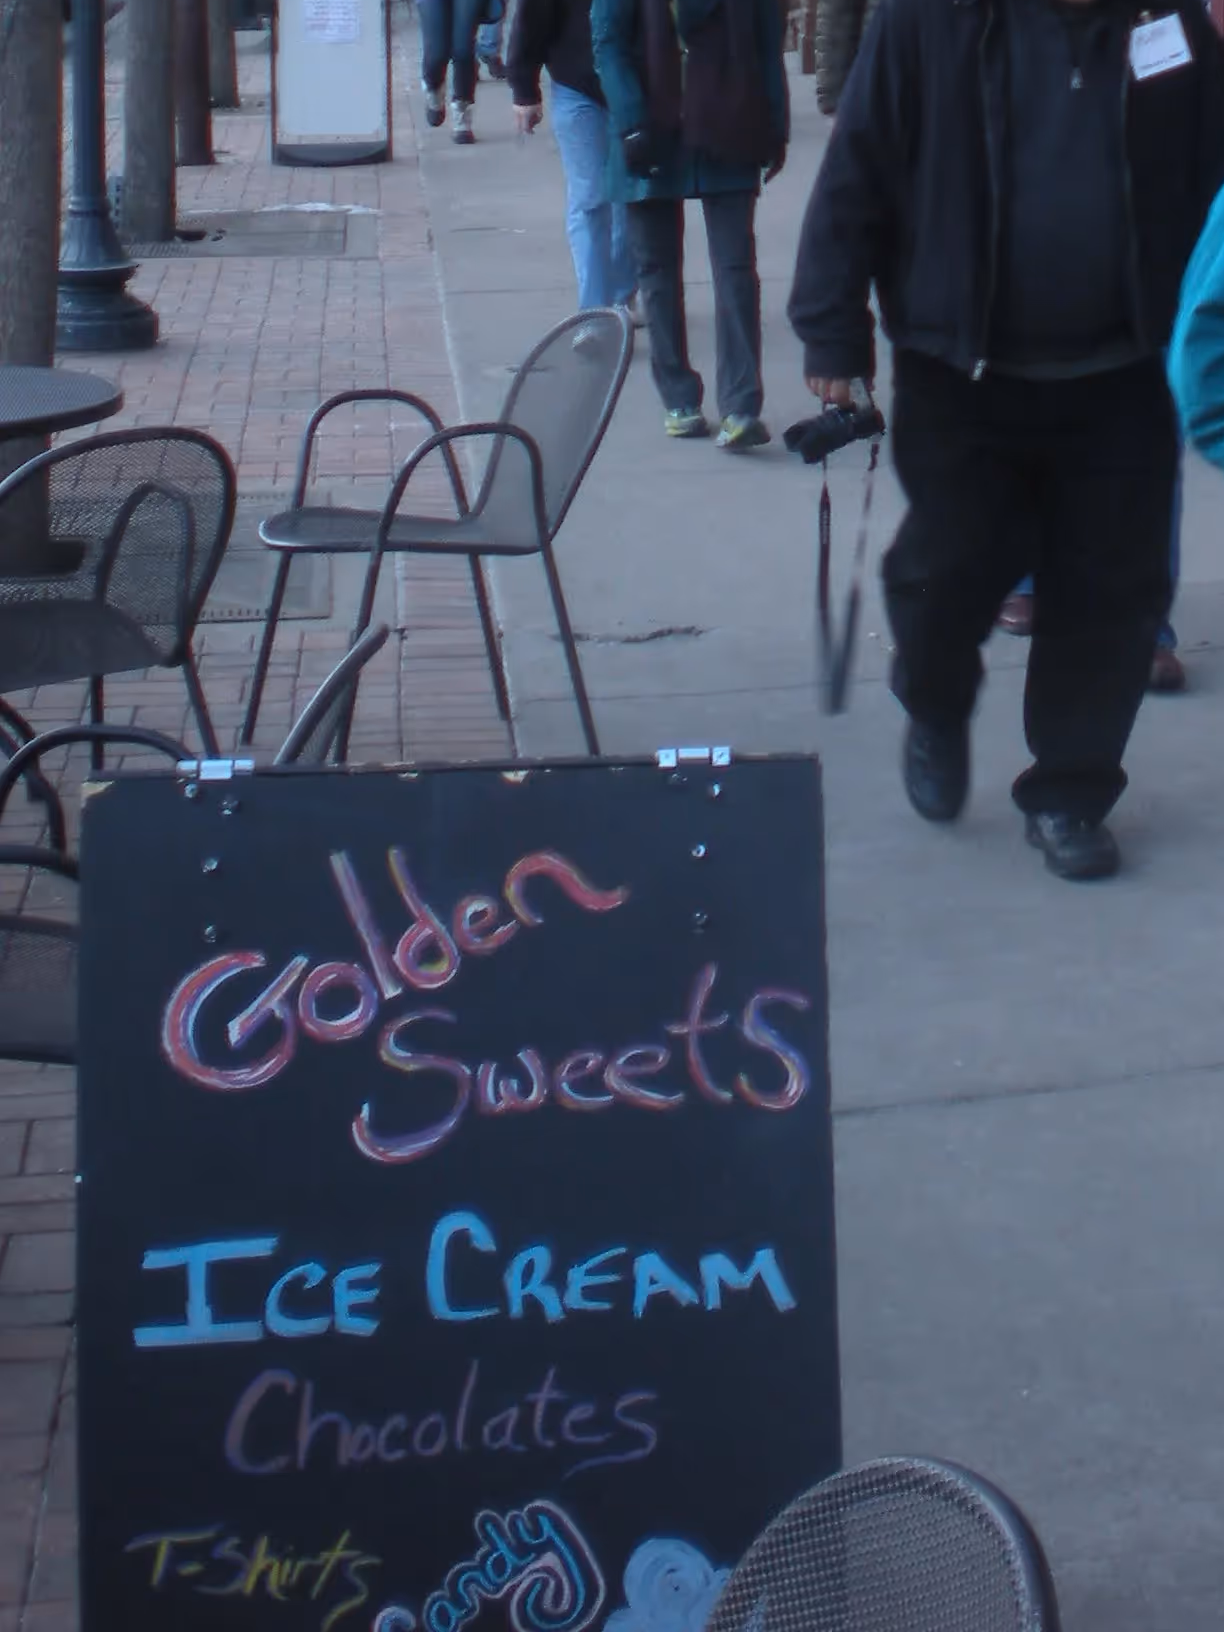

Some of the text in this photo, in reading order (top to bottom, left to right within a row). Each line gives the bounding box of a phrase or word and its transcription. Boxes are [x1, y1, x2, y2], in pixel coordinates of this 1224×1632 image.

[161, 845, 631, 1091] Golden
[351, 964, 811, 1164] Sweets
[425, 1210, 799, 1324] CREAM
[223, 1359, 663, 1479] Chocolates
